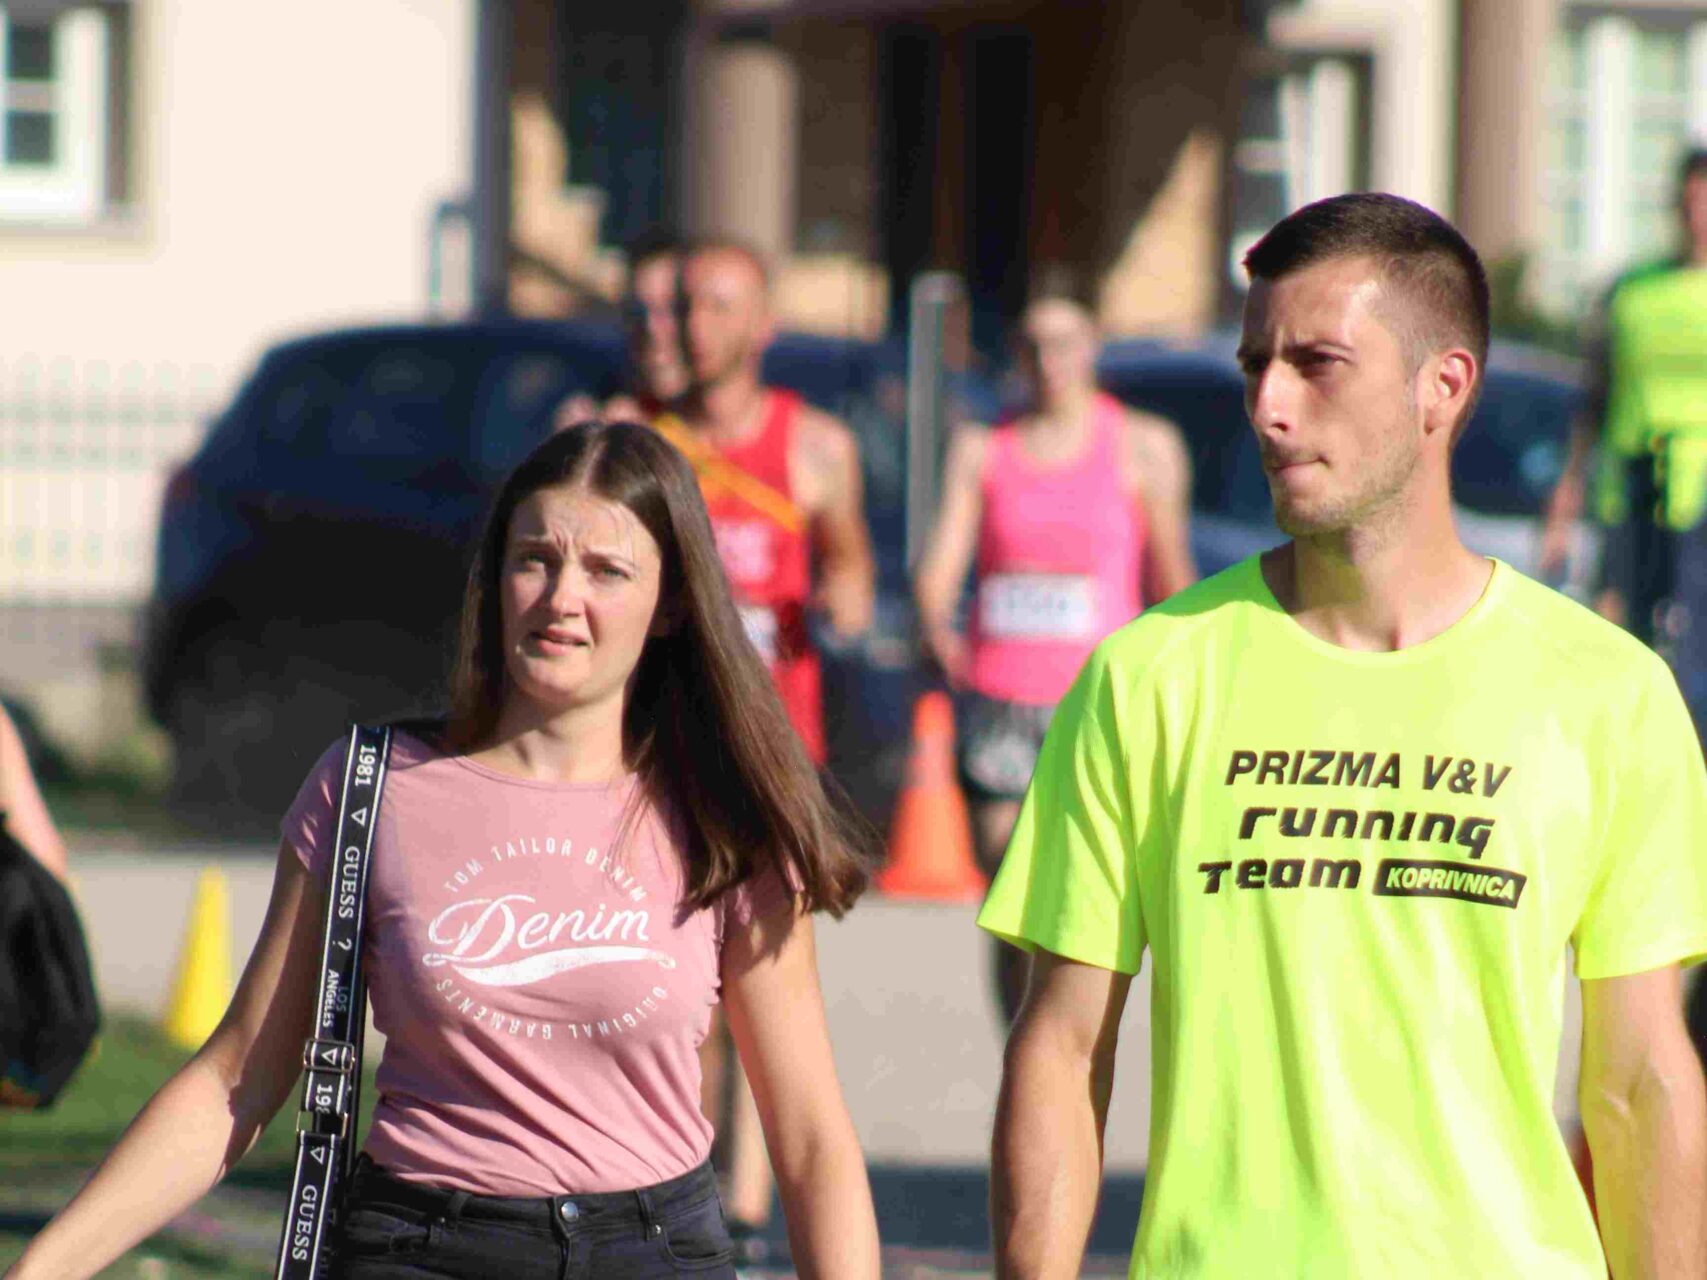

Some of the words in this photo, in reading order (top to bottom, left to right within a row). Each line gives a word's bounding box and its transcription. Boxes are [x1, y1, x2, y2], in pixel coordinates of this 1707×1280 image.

[354, 743, 377, 787] 1981
[1224, 749, 1401, 789] PRIZMA
[1421, 754, 1513, 798] V&V
[1237, 806, 1496, 860] running
[337, 845, 361, 919] GUESS
[443, 858, 484, 893] TOM
[491, 837, 573, 862] TAILOR
[584, 846, 648, 903] DENIM
[1385, 866, 1516, 901] KOPRIVNICA
[427, 893, 650, 962] Denim
[322, 968, 340, 1028] ANGELES
[335, 985, 349, 1013] LOS
[435, 978, 553, 1040] GARMENTS
[568, 984, 669, 1039] ORIGINAL
[292, 1184, 318, 1261] GUESS
